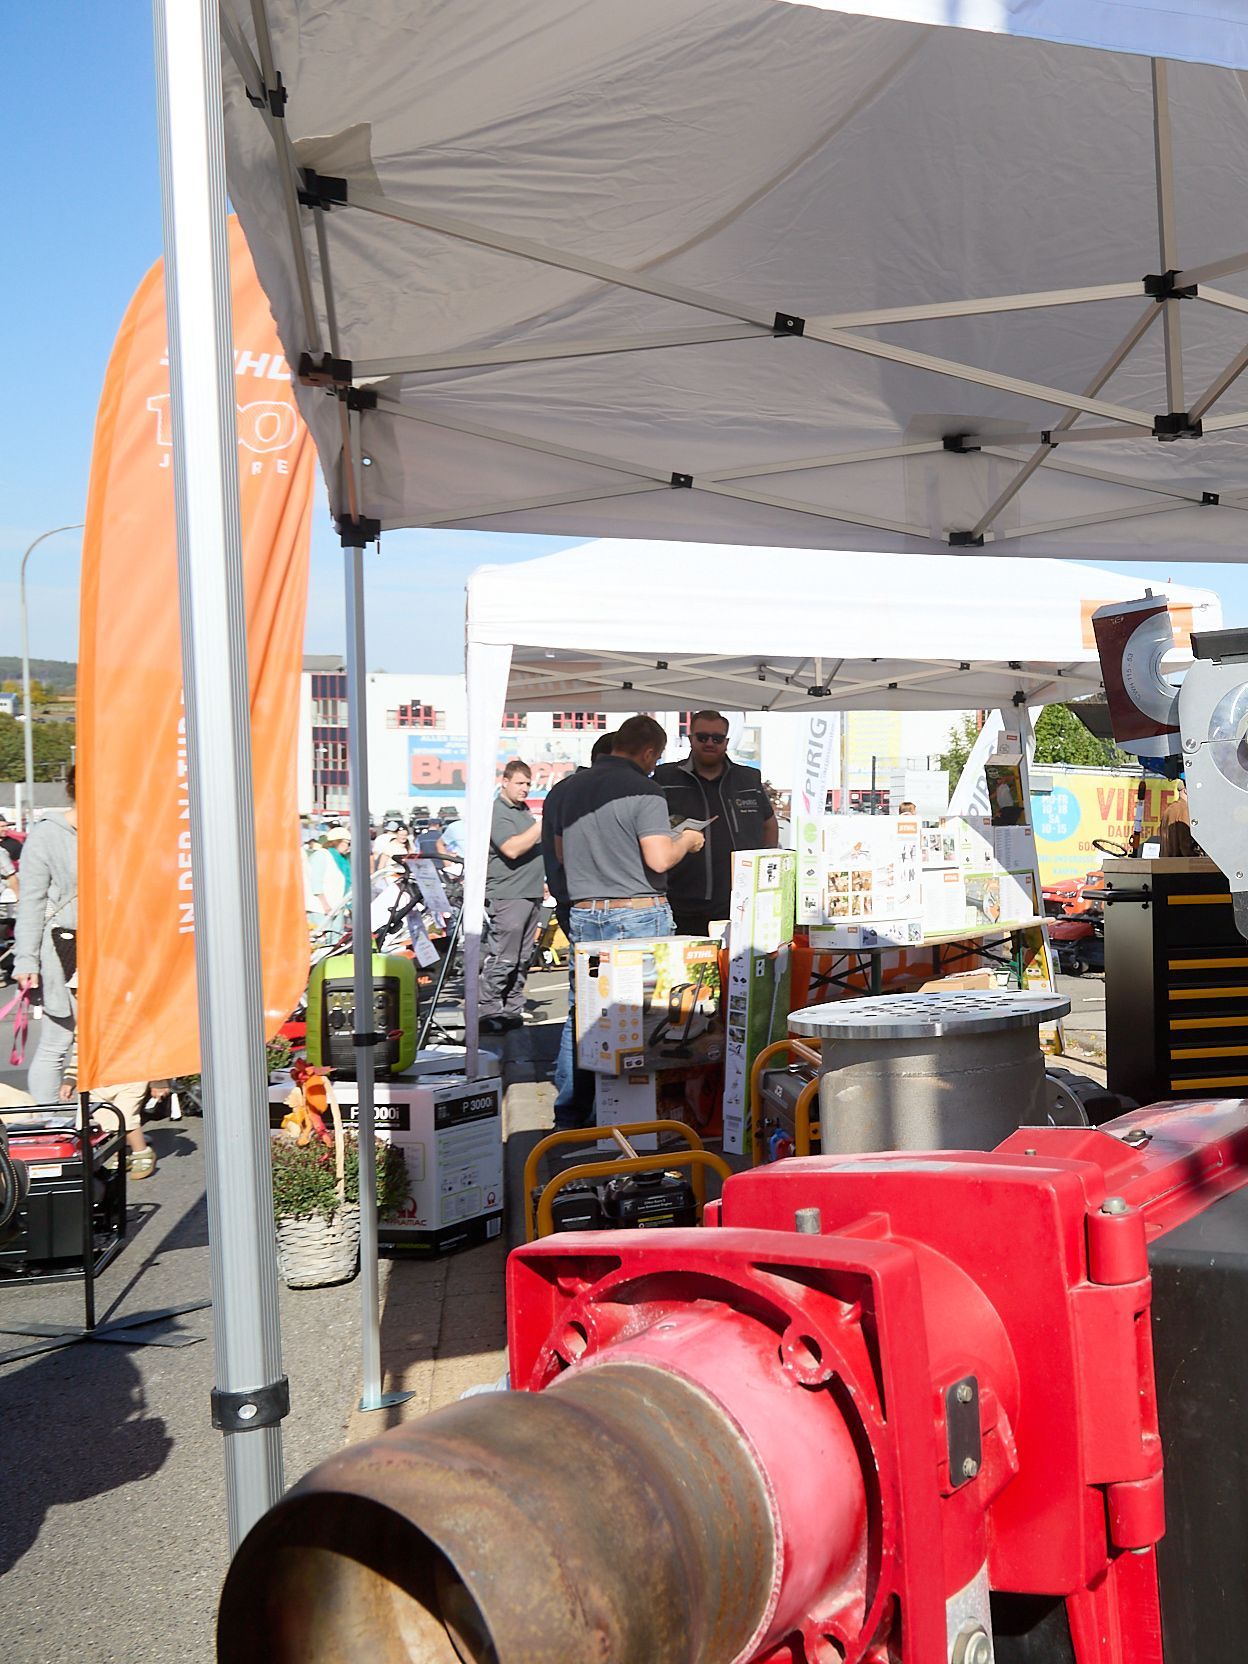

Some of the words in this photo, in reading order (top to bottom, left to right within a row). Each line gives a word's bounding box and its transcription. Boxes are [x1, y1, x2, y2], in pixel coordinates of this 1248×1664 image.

[146, 393, 298, 453] 10
[159, 453, 289, 475] JRE
[805, 717, 828, 797] PIRIG
[686, 950, 714, 960] STIHL
